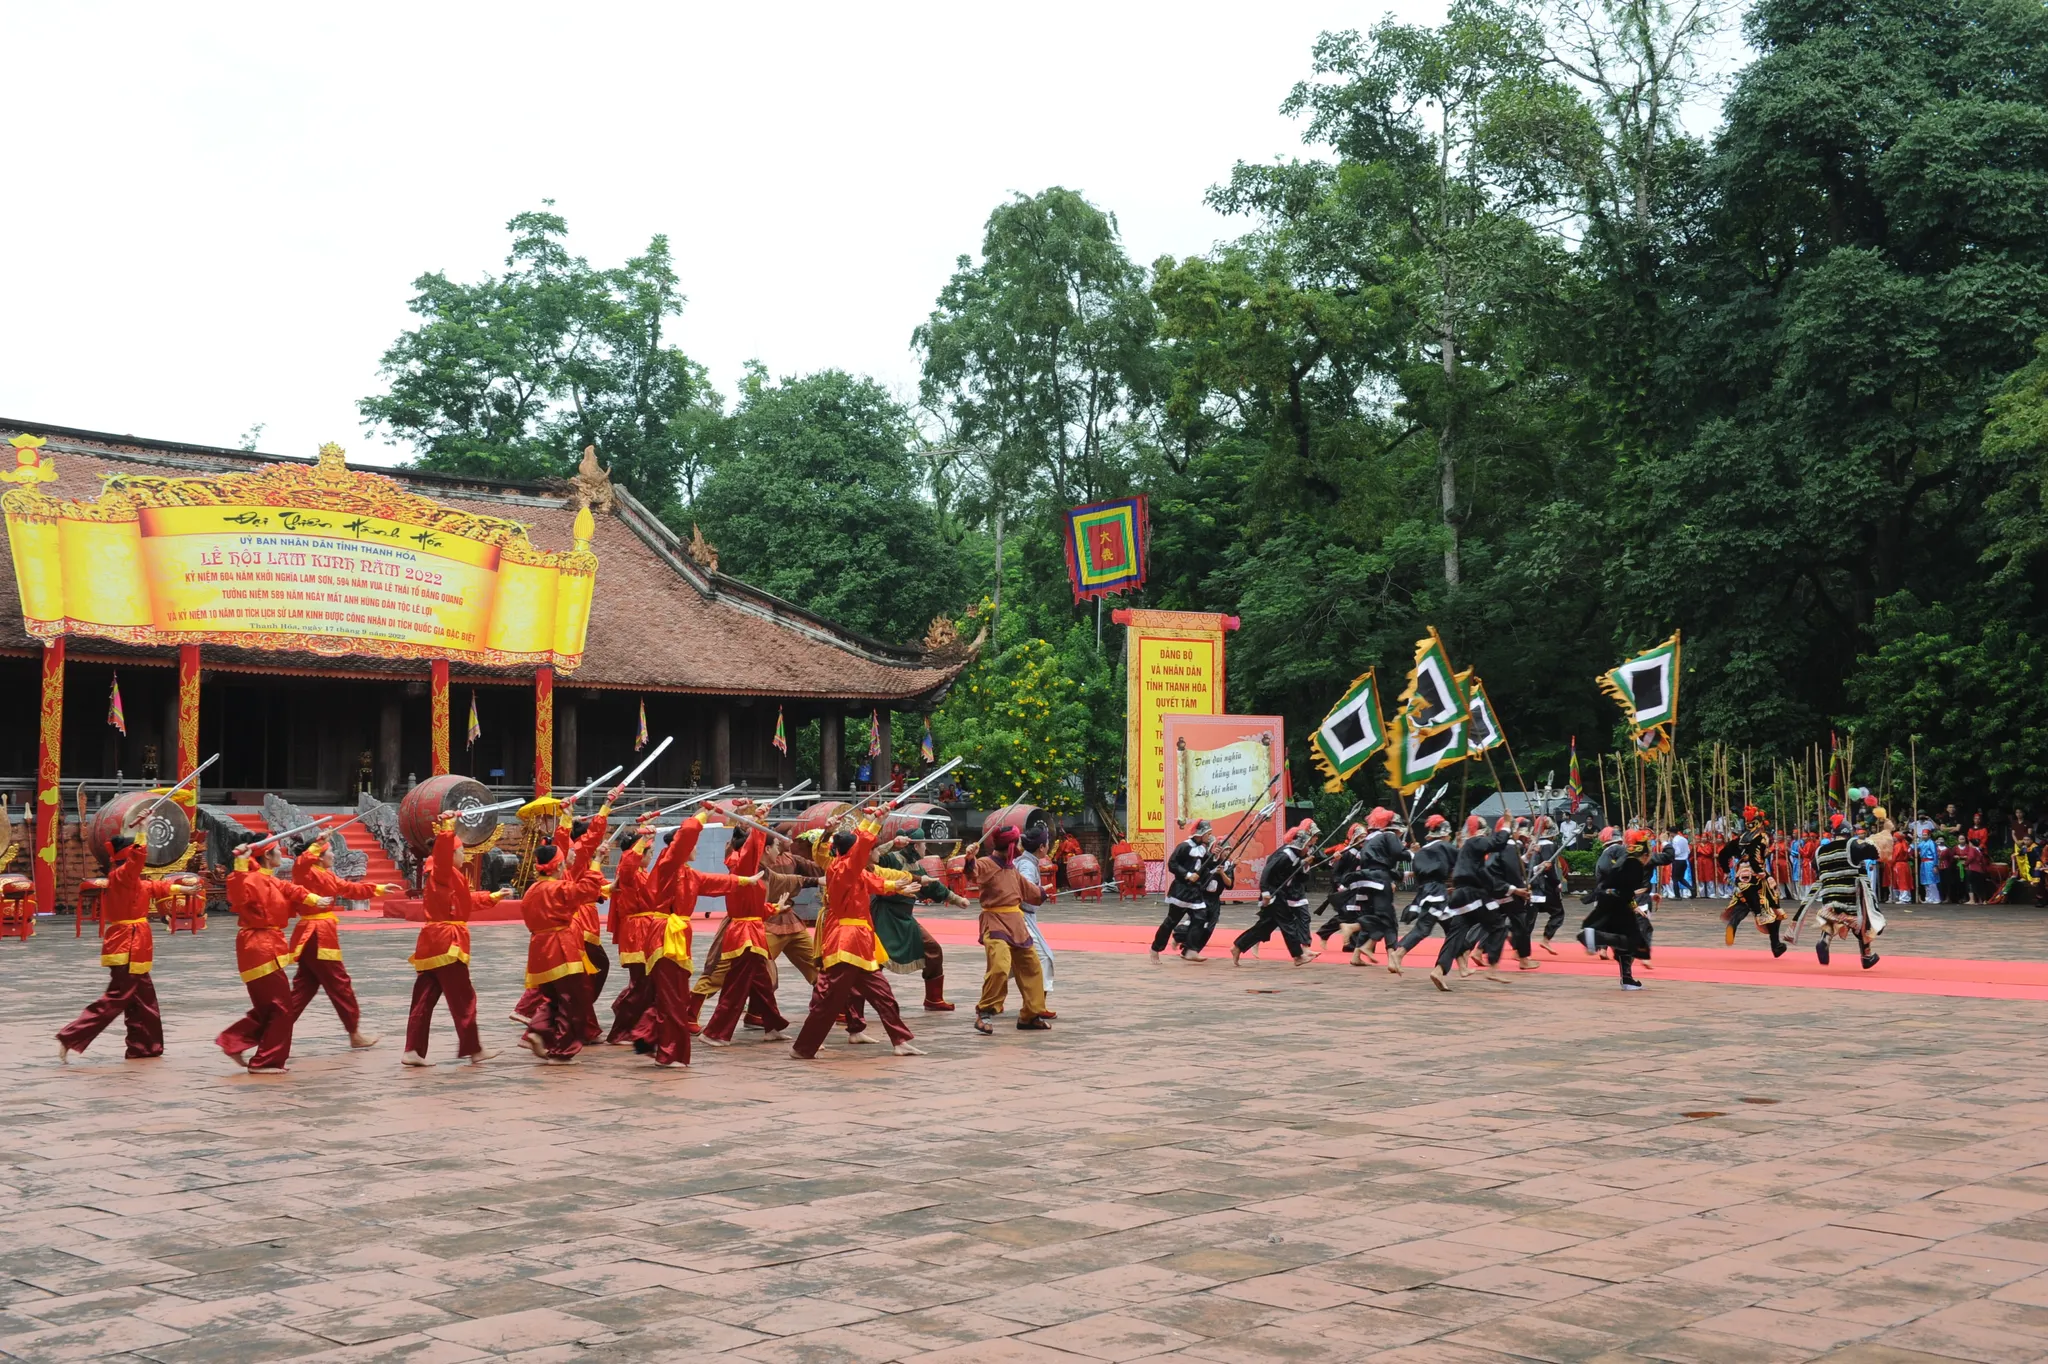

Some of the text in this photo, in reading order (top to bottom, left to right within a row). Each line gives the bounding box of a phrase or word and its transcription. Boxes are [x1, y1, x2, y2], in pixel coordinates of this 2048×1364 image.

[223, 511, 268, 527] Đại
[257, 537, 277, 545] BAN
[281, 537, 309, 547] NHÂN
[312, 539, 333, 549] DÂN
[336, 540, 358, 552] TỈNH
[361, 545, 393, 557] THANH
[396, 550, 417, 561] HÓA
[201, 546, 443, 586] LỄ HỘI LAM KINH NĂM 2022
[185, 569, 463, 605] KỶ NIỆM 604 NĂM KHỞI NGHĨA LAM SƠN, 594 NĂM VUA LÊ THÁI TỔ ĐĂNG QUANG
[222, 587, 432, 617] TƯỞNG NIỆM 589 NĂM NGÀY MẤT ANH HÙNG DÂN TỘC LÊ LỢI
[167, 606, 476, 643] VÀ KỶ NIỆM 10 NĂM DI TÍCH LỊCH SỬ LAM KINH ĐƯỢC CÔNG NHẬN DI TÍCH QUỐC GIA ĐẶC BIỆT
[302, 624, 322, 632] ngày
[336, 626, 360, 635] tháng
[388, 632, 406, 640] 2022
[1160, 647, 1193, 662] ĐẢNG BỘ
[1151, 663, 1202, 676] VÀ NHÂN DÂN
[1146, 678, 1207, 692] TỈNH THANH HÓA
[1156, 694, 1197, 708] QUYẾT TÂM
[1232, 766, 1247, 776] hung
[1212, 800, 1226, 810] thay
[1147, 809, 1162, 821] VÀO
